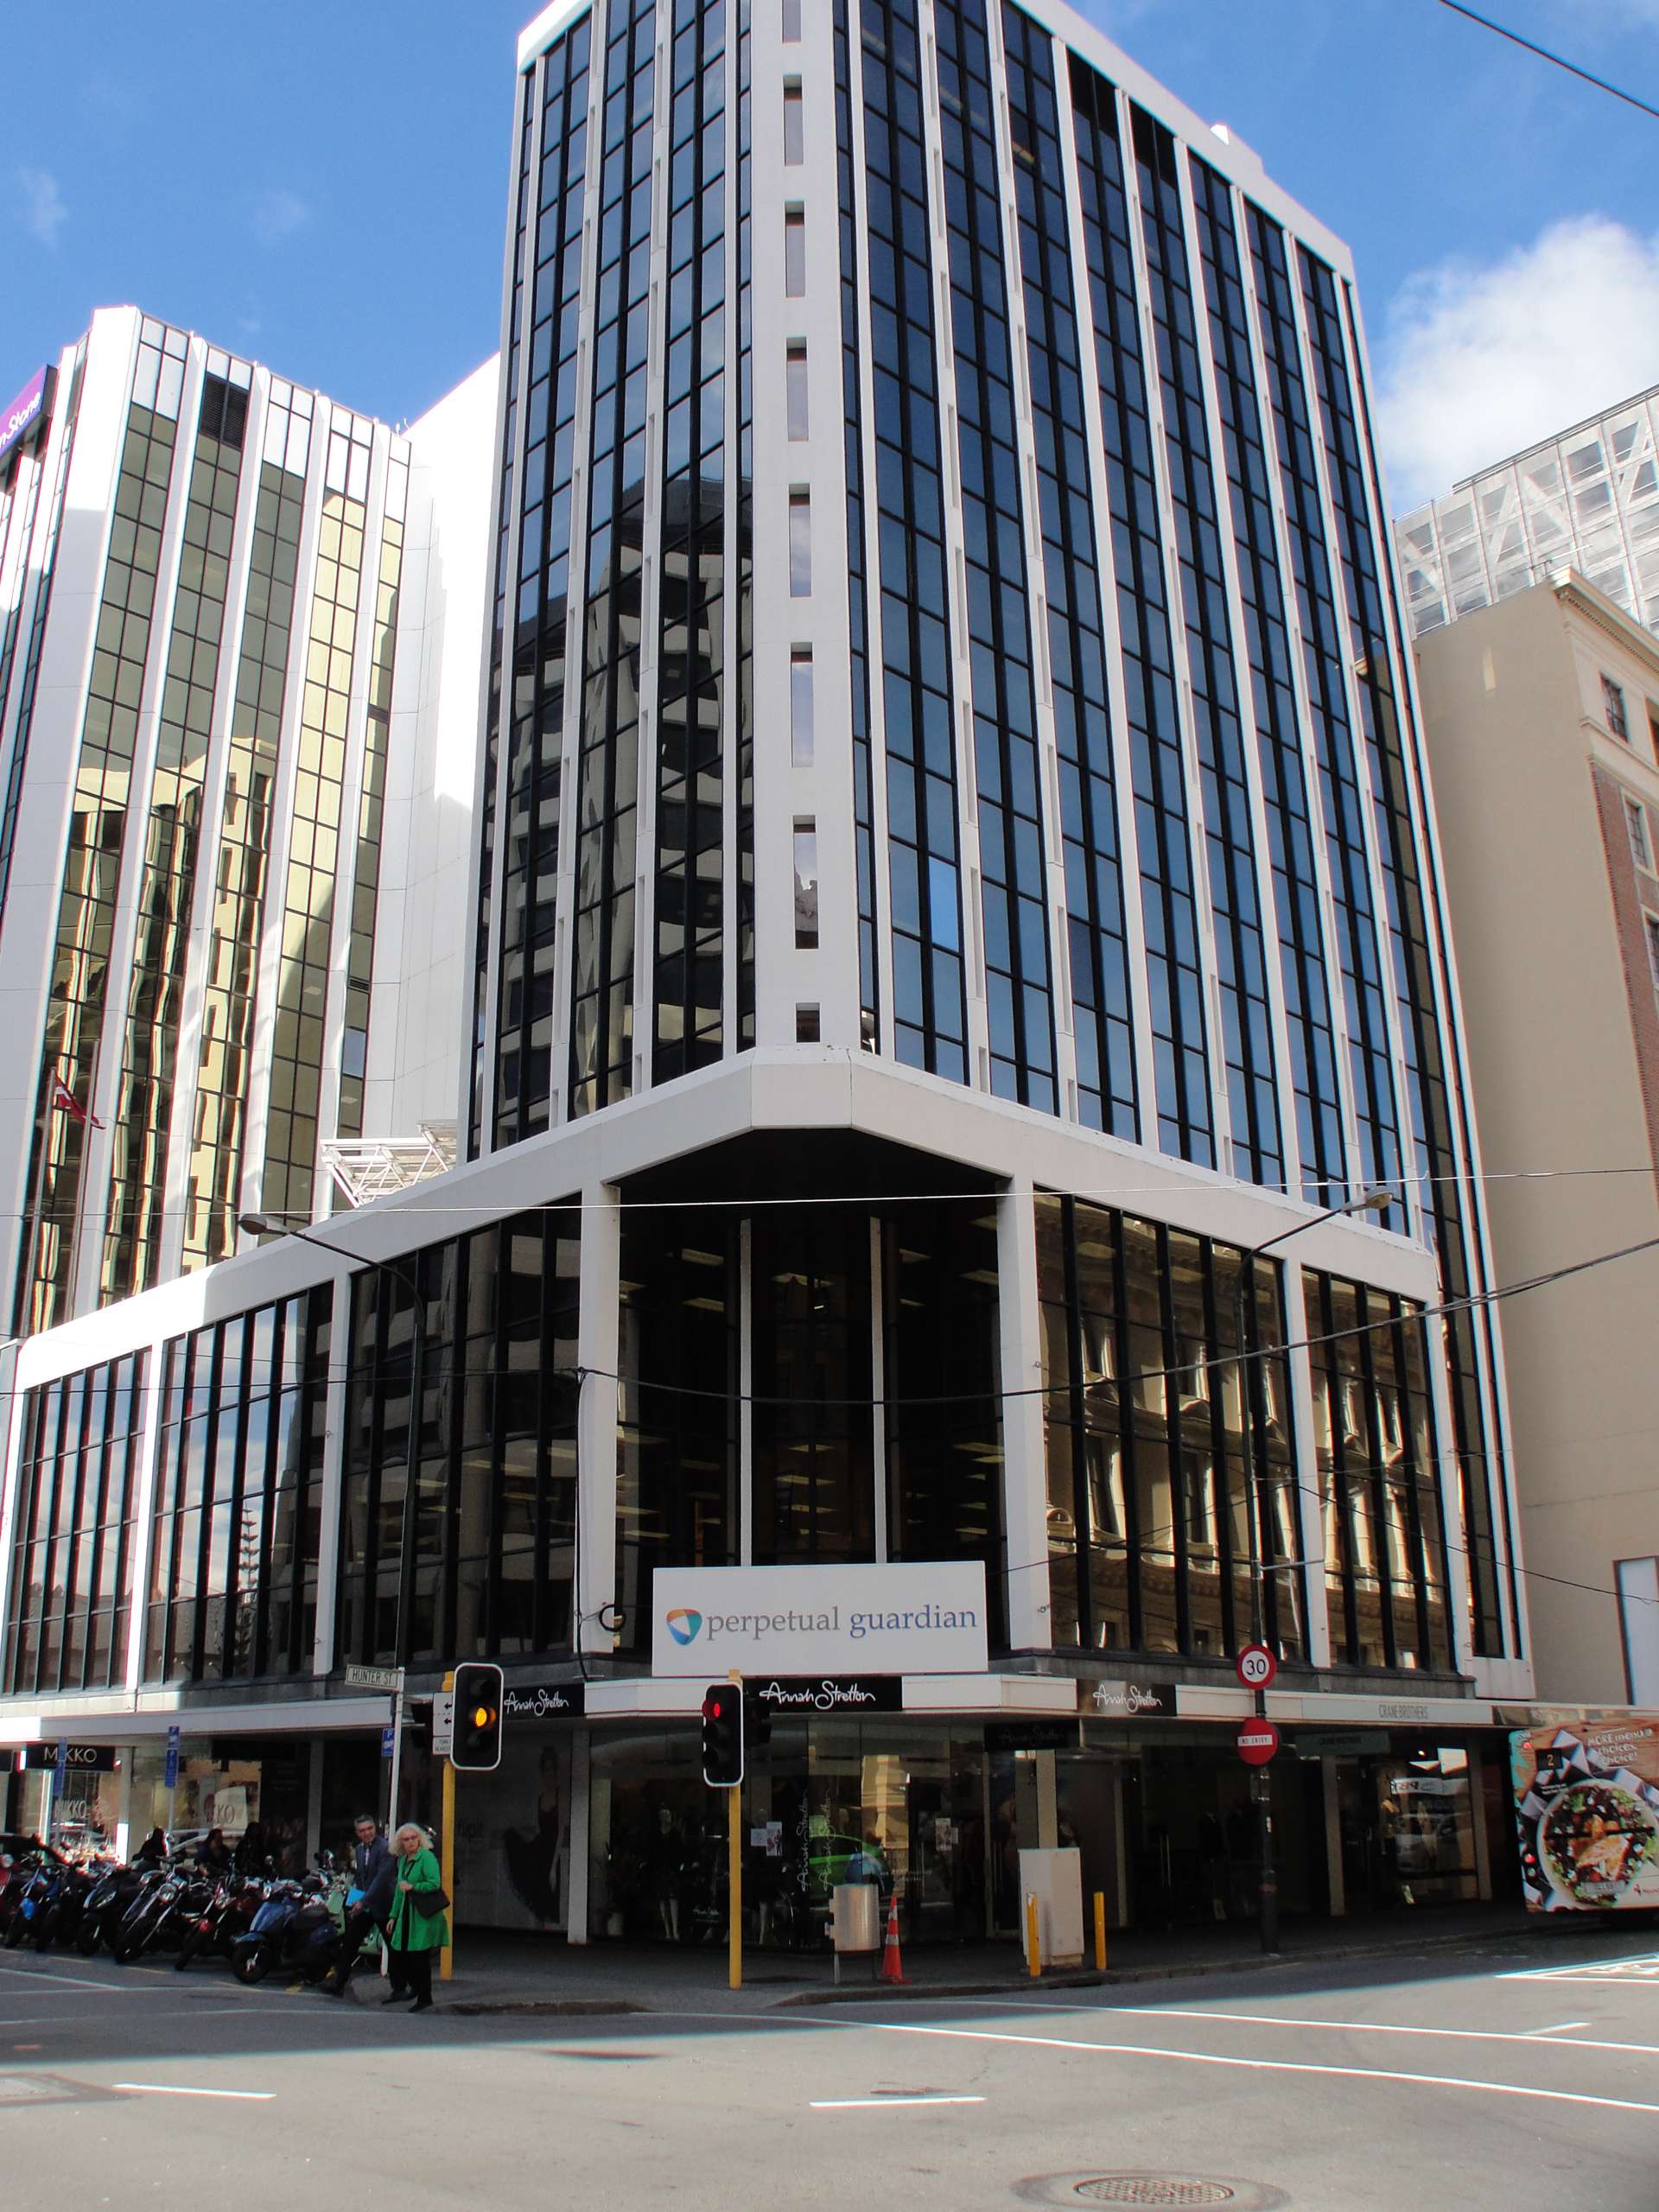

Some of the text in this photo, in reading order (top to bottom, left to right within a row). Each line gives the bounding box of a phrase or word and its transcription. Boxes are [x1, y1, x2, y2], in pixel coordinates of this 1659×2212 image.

[707, 1605, 977, 1641] perpetual guardian
[1246, 1659, 1266, 1675] 30
[352, 1668, 393, 1684] HUNTER ST
[504, 1688, 569, 1716] Annah Stretton
[759, 1681, 876, 1710] Annah Stretton
[1092, 1684, 1163, 1713] Annah Stretton
[1587, 1733, 1614, 1746] MORE
[43, 1747, 97, 1764] MKKO
[1547, 1754, 1555, 1767] 2
